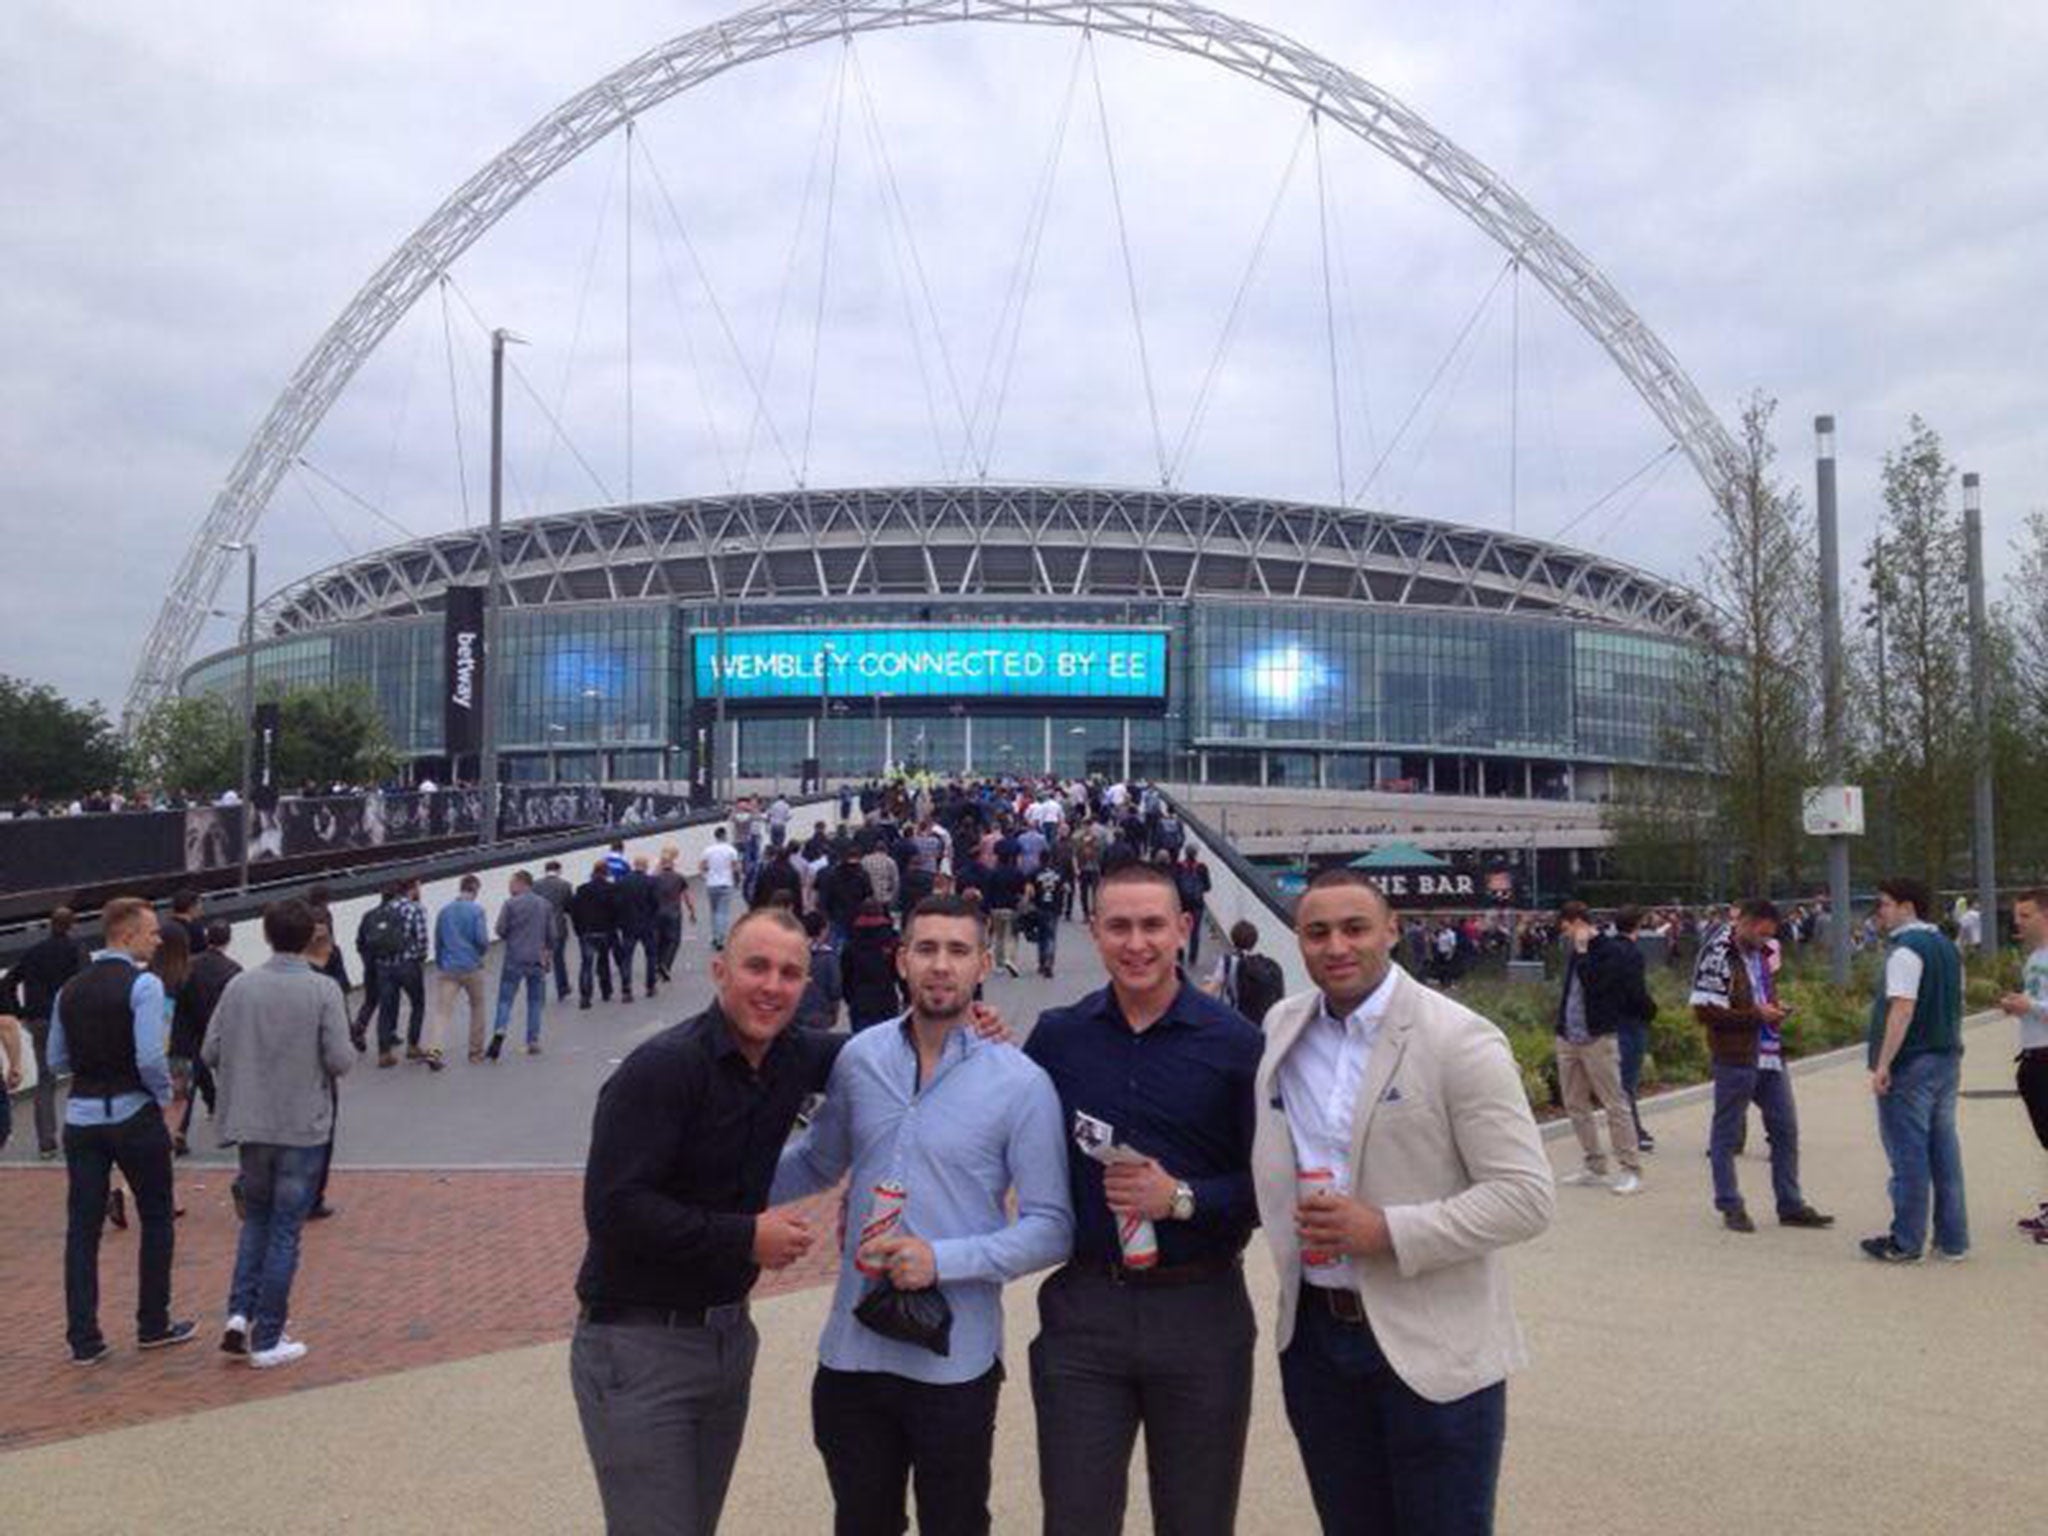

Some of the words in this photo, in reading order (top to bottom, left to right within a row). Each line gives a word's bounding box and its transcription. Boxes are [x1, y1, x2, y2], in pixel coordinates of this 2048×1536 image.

[452, 632, 476, 708] betway
[859, 650, 1043, 677] CONNECTED
[1058, 651, 1094, 676] BY
[1109, 651, 1145, 677] EE
[1369, 876, 1407, 895] HE
[1418, 875, 1474, 894] BAR
